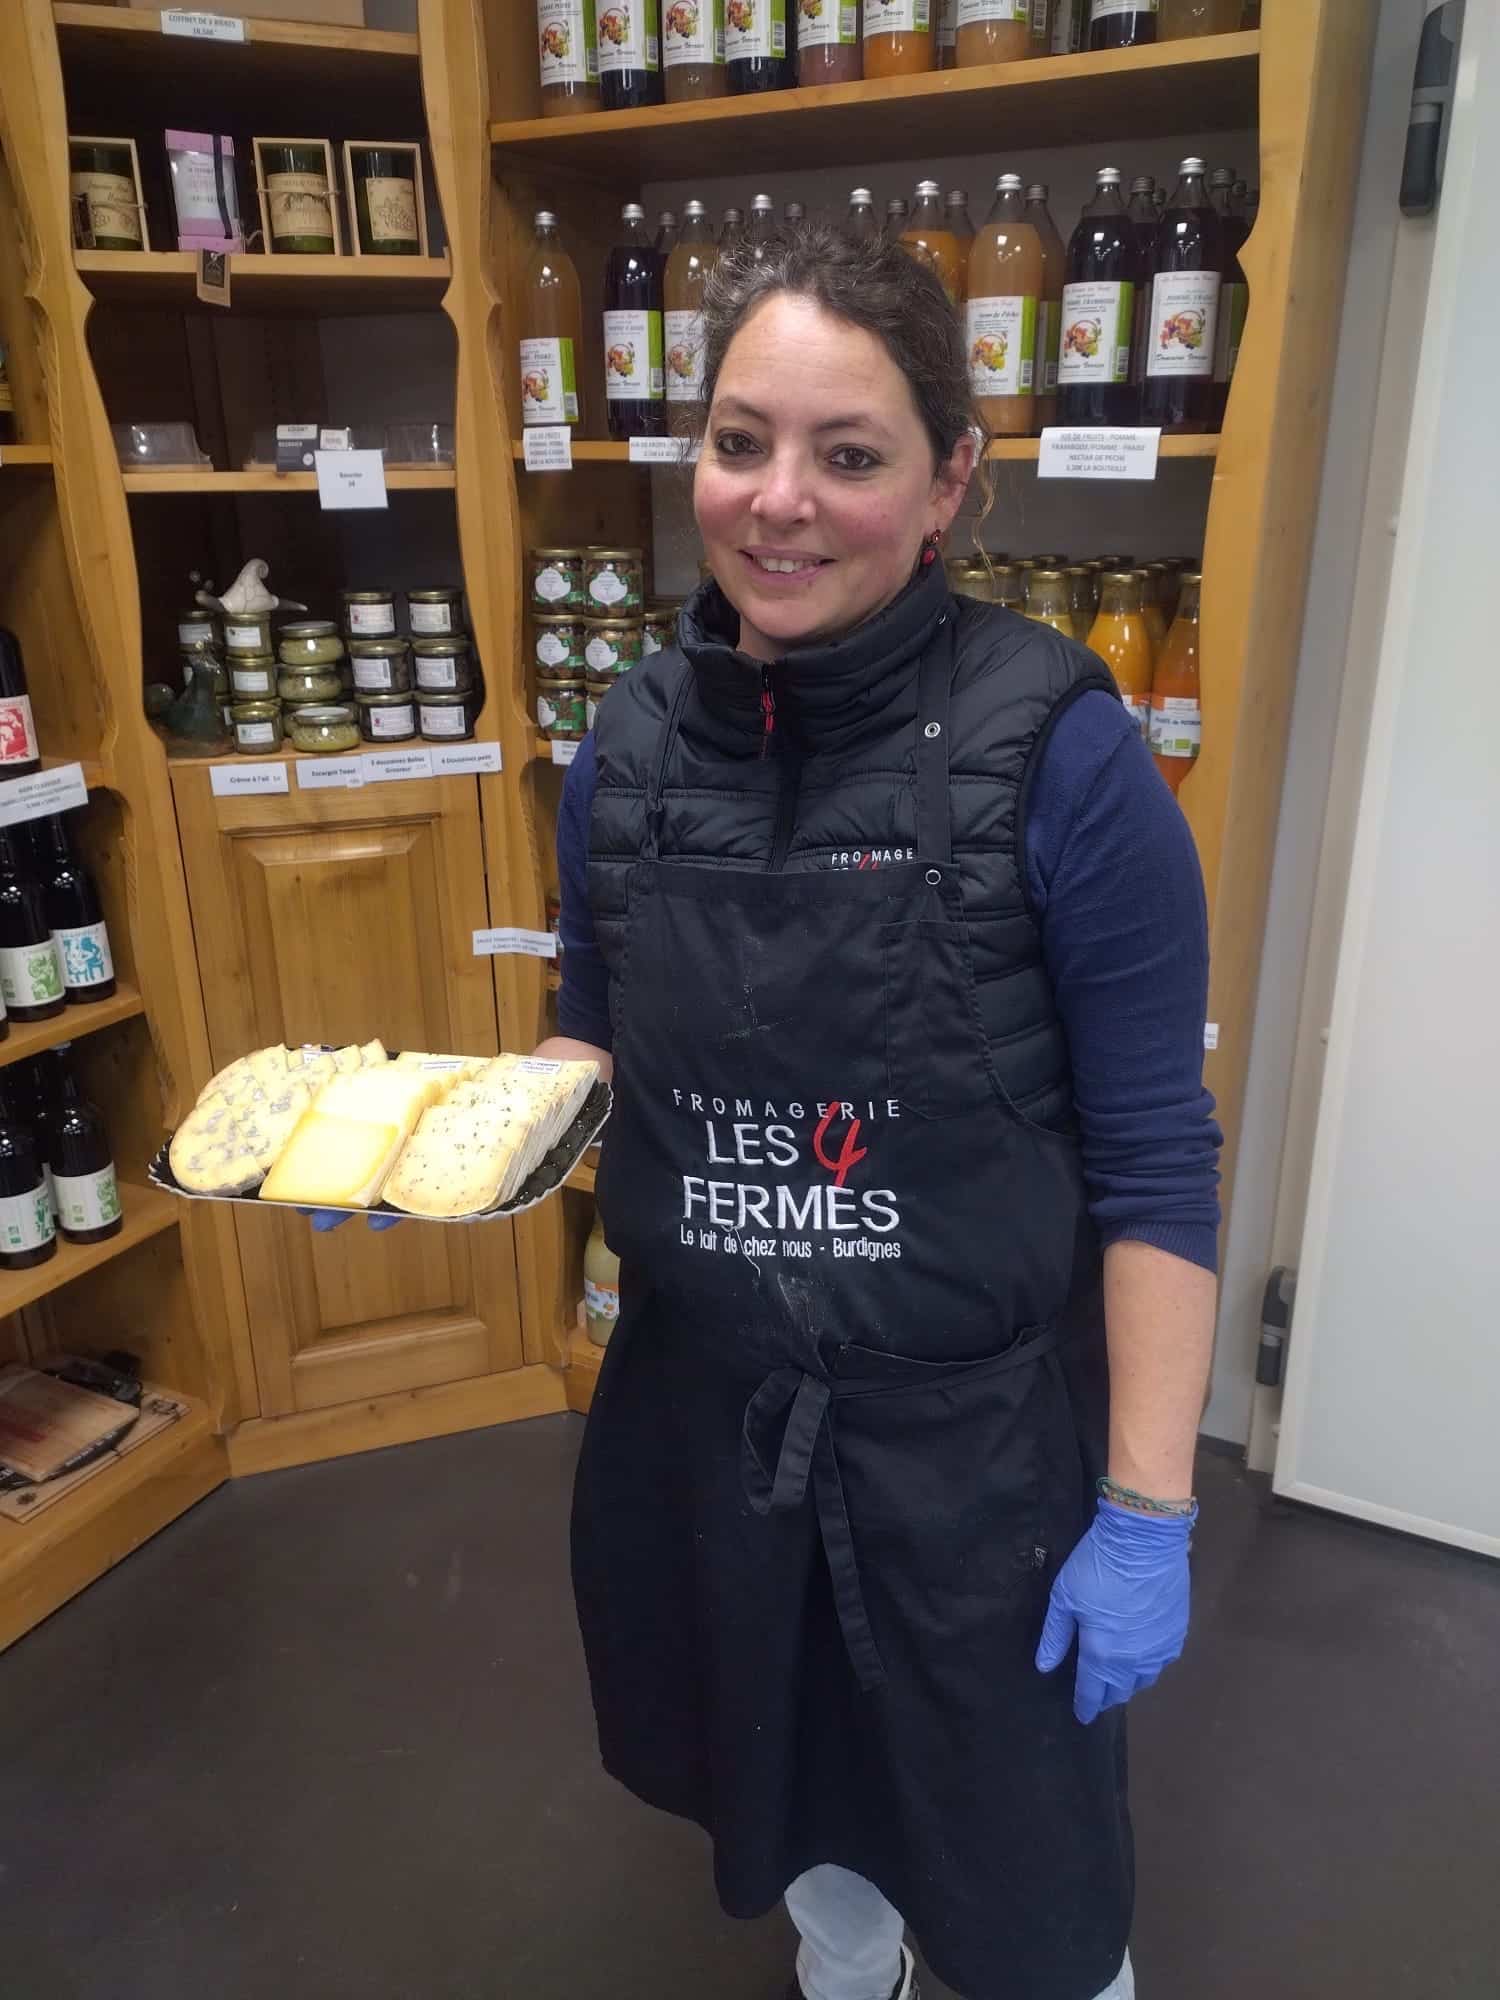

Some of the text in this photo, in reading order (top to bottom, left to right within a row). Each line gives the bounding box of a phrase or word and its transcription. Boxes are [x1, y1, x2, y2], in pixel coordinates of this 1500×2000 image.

[672, 1088, 901, 1120] FROMAGERIE
[705, 1101, 868, 1188] LES 4
[682, 1175, 901, 1233] FERMES
[680, 1223, 694, 1246] Le
[699, 1229, 718, 1251] lait
[723, 1234, 738, 1254] de
[744, 1238, 777, 1257] chez
[783, 1241, 812, 1258] nous
[832, 1236, 901, 1262] Burdignes
